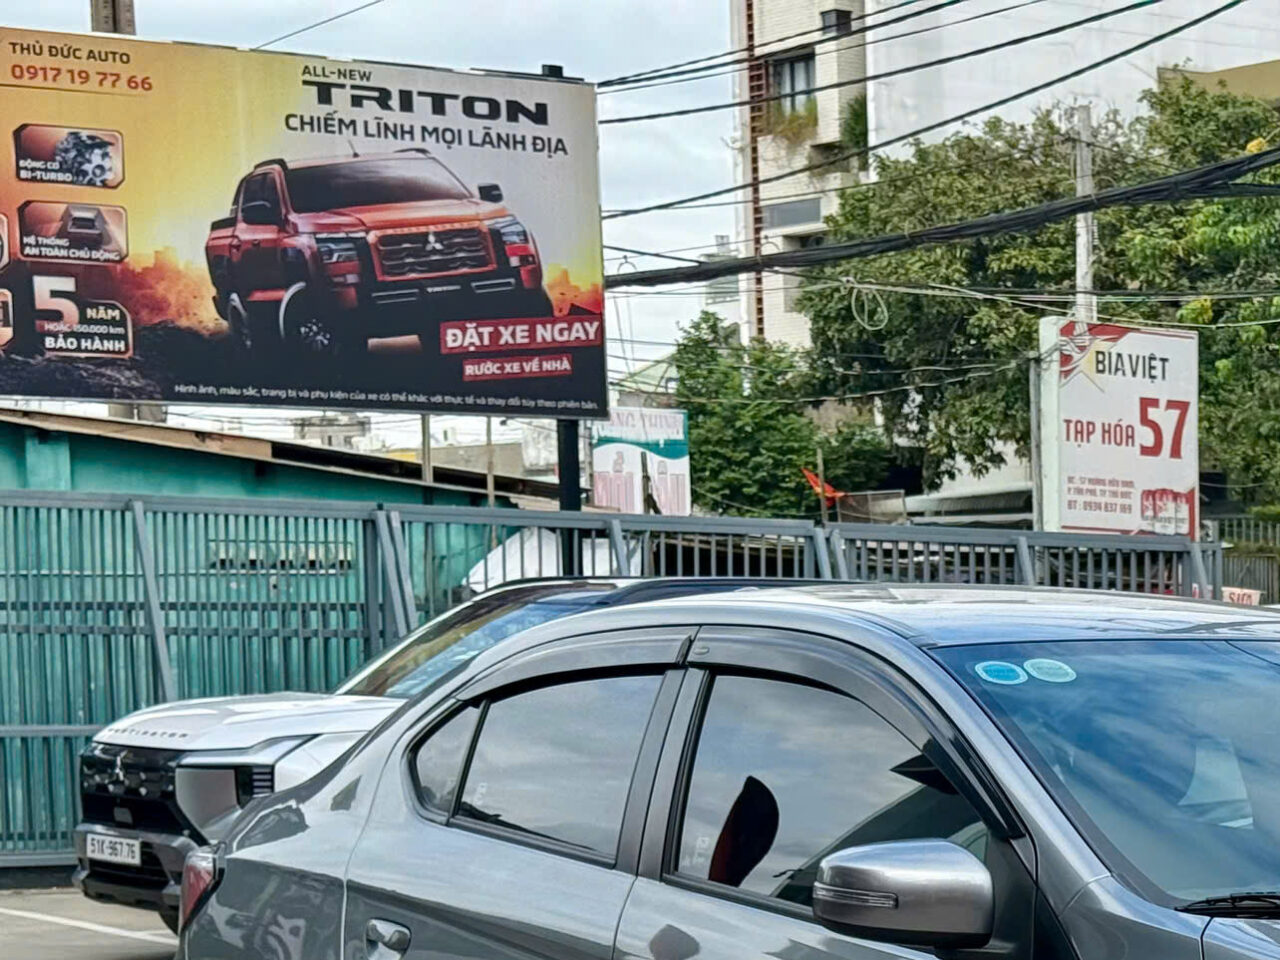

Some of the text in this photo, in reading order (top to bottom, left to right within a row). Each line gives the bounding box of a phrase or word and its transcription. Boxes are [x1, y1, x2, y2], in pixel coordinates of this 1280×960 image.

[8, 40, 131, 65] THỦ ĐỨC AUTO
[11, 64, 153, 91] 0917 19 77 66
[302, 64, 372, 82] ALL-NEW
[302, 80, 549, 126] TRITON
[285, 110, 569, 159] CHIẾM LĨNH MỌI LÃNH ĐỊA
[20, 170, 73, 181] BI-TURBO
[24, 247, 40, 256] AN
[32, 275, 120, 333] 5 NĂM
[45, 334, 126, 351] BẢO HÀNH
[446, 321, 600, 351] ĐẶT XE NGAY
[464, 357, 571, 376] RƯỚC XE VỀ NHÀ
[1095, 350, 1170, 383] BIA VIỆT
[1063, 397, 1191, 459] TẠP HÓA 57
